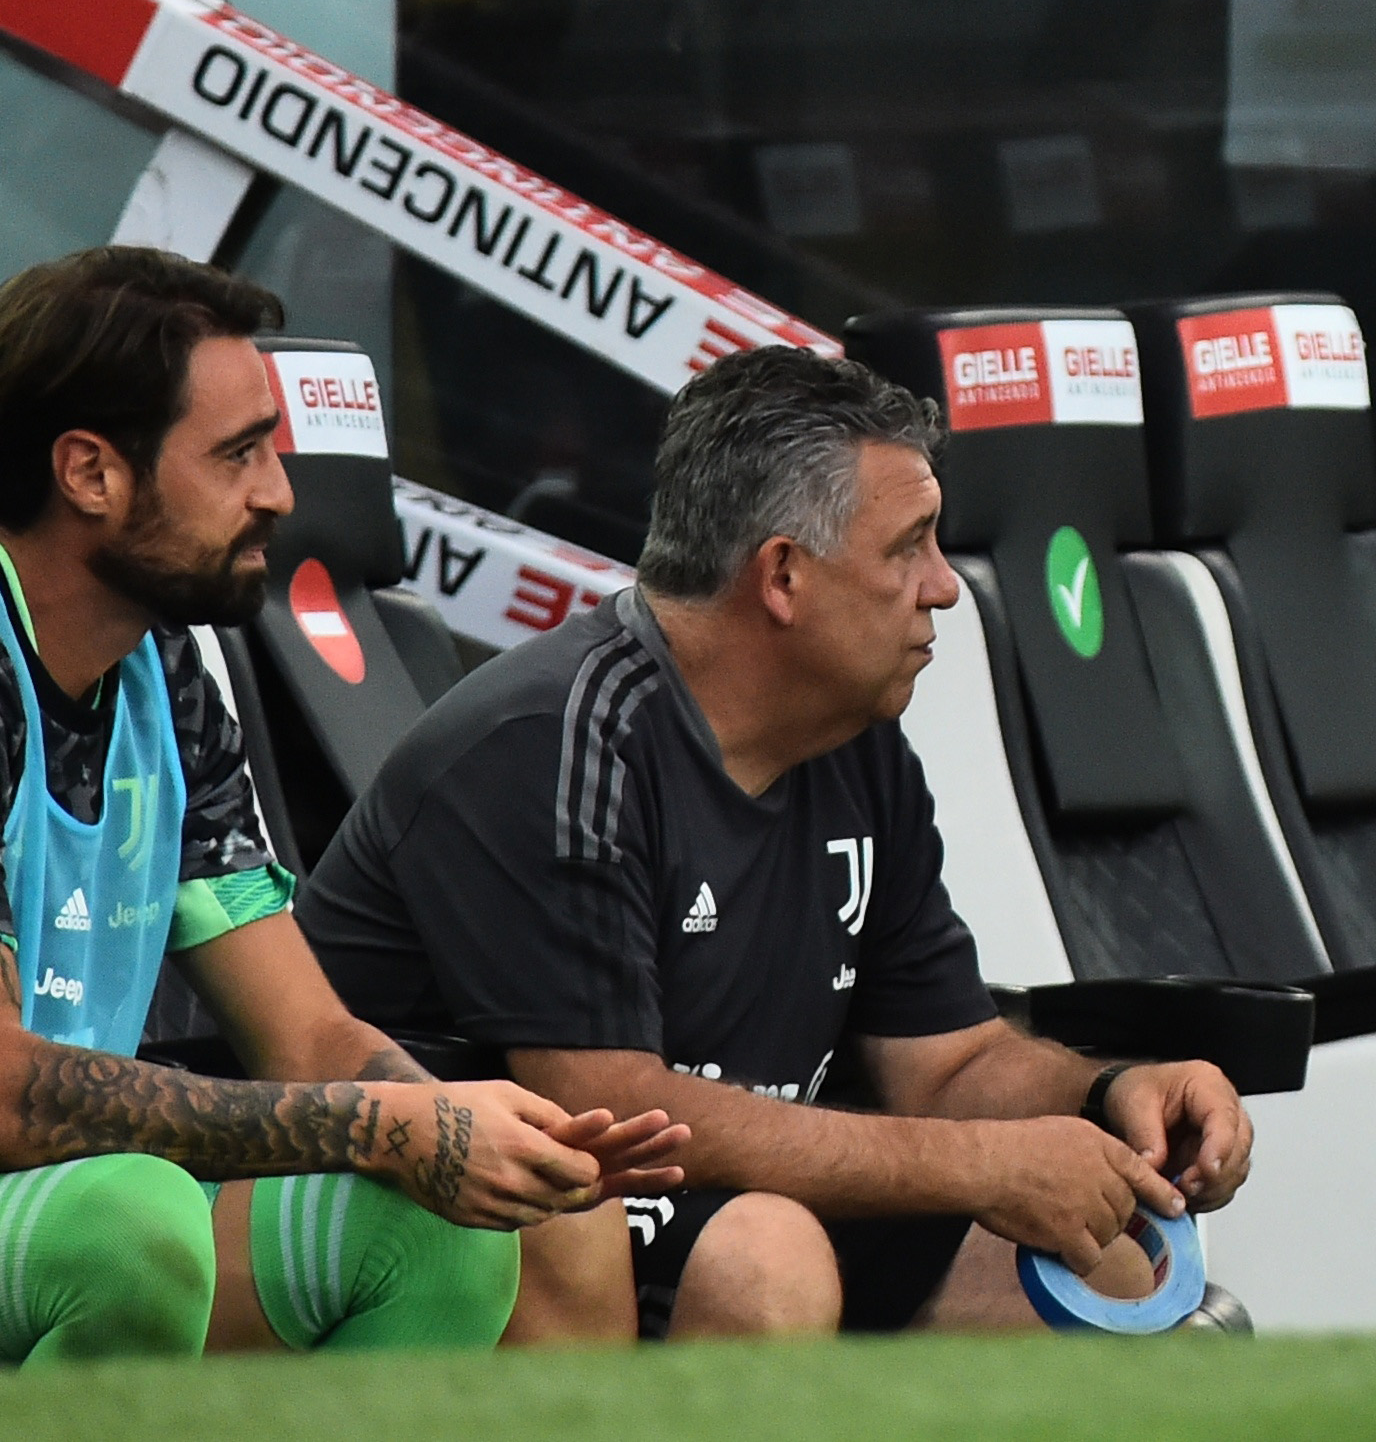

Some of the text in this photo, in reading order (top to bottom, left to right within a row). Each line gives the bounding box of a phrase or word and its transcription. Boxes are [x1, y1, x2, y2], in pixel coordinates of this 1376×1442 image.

[191, 43, 677, 340] ANTINCENDIO
[953, 346, 1040, 389] GIELLE
[1064, 346, 1136, 378] GIELLE
[1193, 331, 1274, 376] GIELLE
[299, 377, 377, 412] GIELLE
[33, 967, 84, 1006] Jeep
